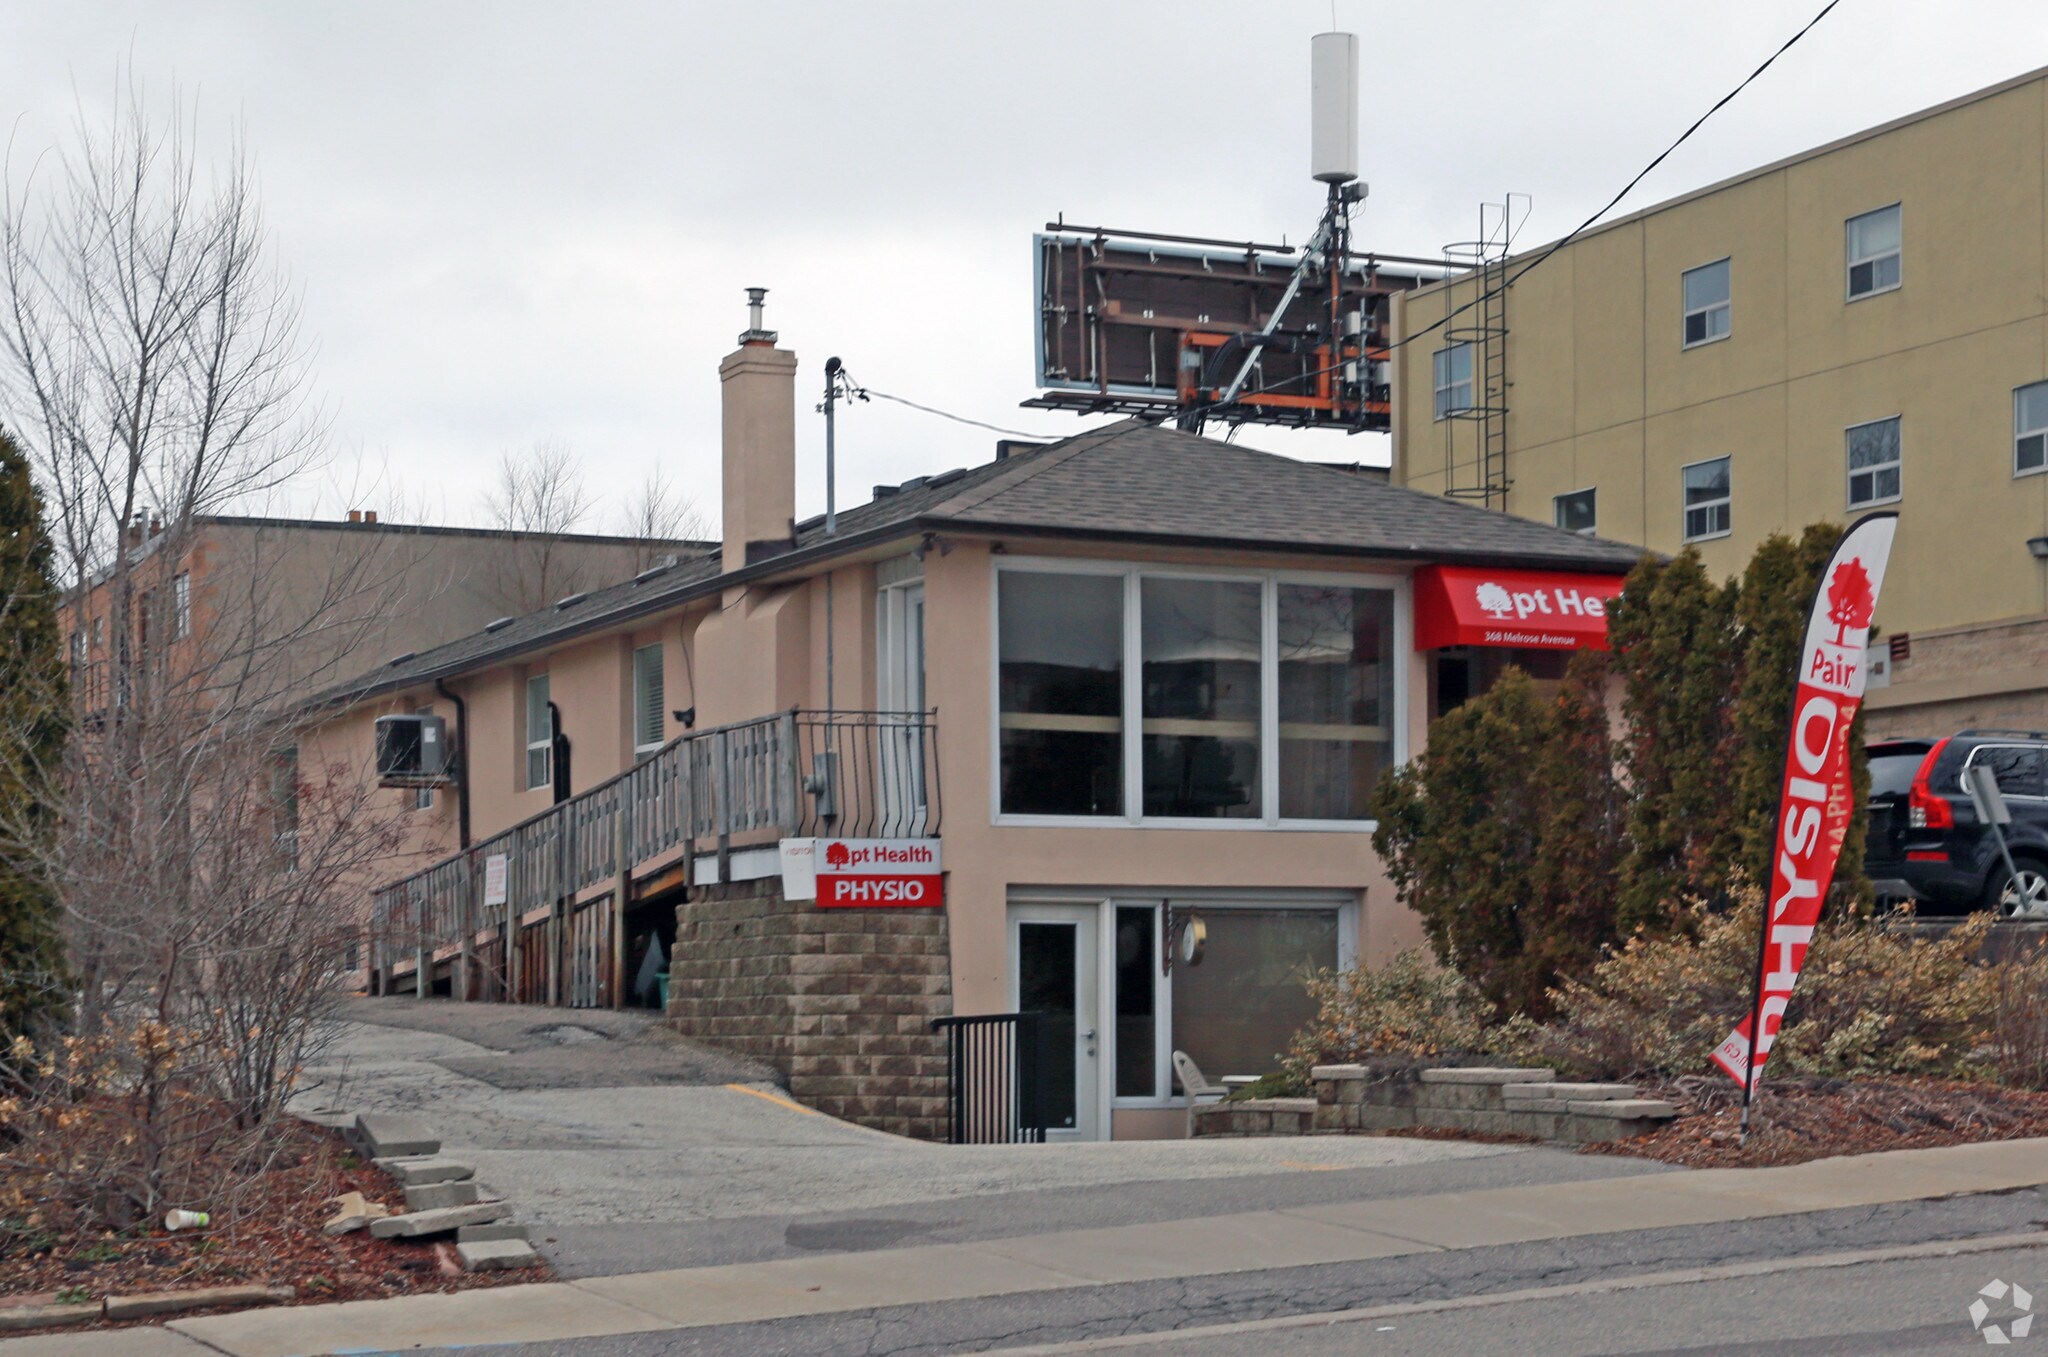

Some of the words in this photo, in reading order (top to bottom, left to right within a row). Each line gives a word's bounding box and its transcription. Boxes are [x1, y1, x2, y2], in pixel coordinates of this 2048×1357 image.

[1511, 589, 1552, 619] pt
[1554, 588, 1606, 617] He
[1503, 631, 1540, 644] Melrose
[1541, 633, 1576, 646] Avenue
[851, 847, 870, 867] pt
[874, 845, 933, 863] Health
[1754, 696, 1837, 1054] PHYSIO
[835, 880, 924, 901] PHYSIO
